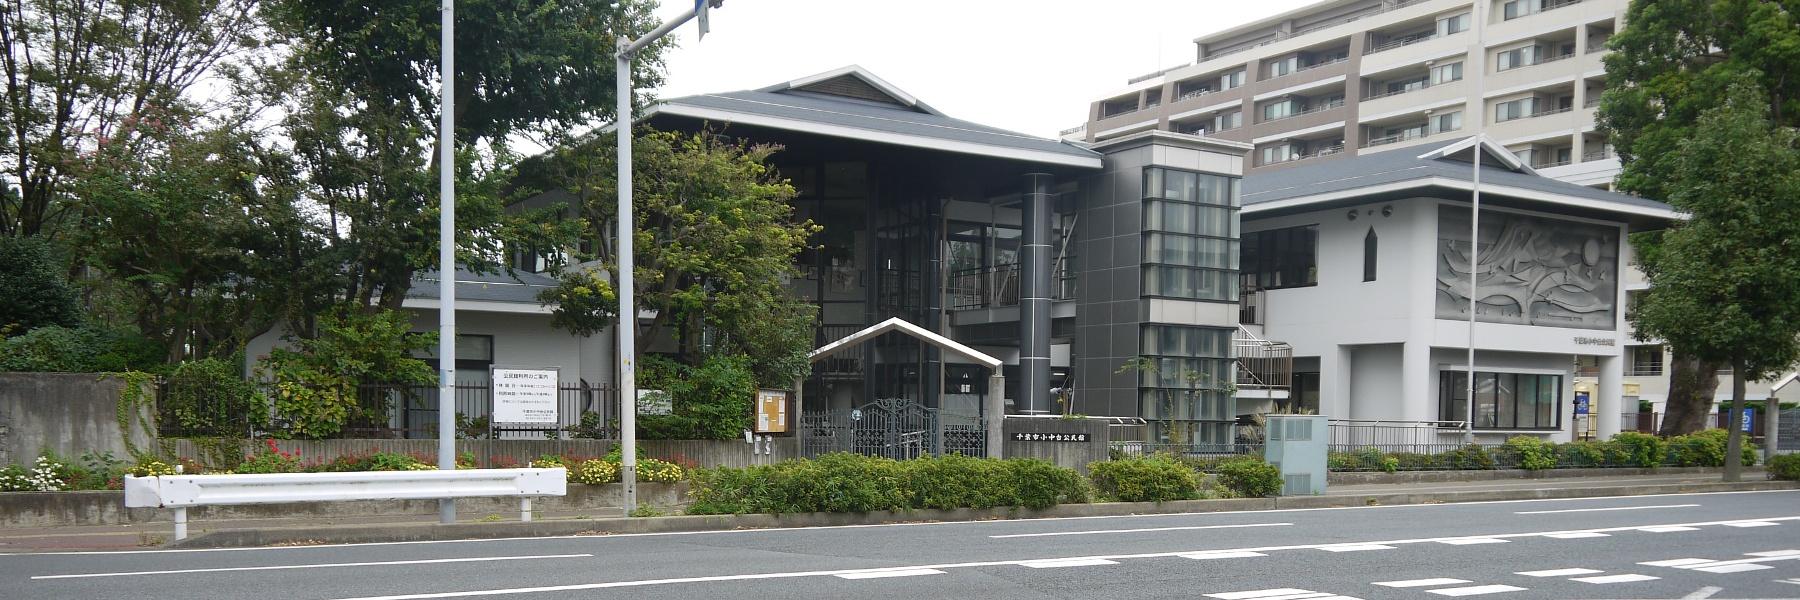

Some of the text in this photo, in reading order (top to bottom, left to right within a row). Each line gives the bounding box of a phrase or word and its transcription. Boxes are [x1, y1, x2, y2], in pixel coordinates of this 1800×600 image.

[1016, 433, 1085, 442] 千葉市小中台公民館
